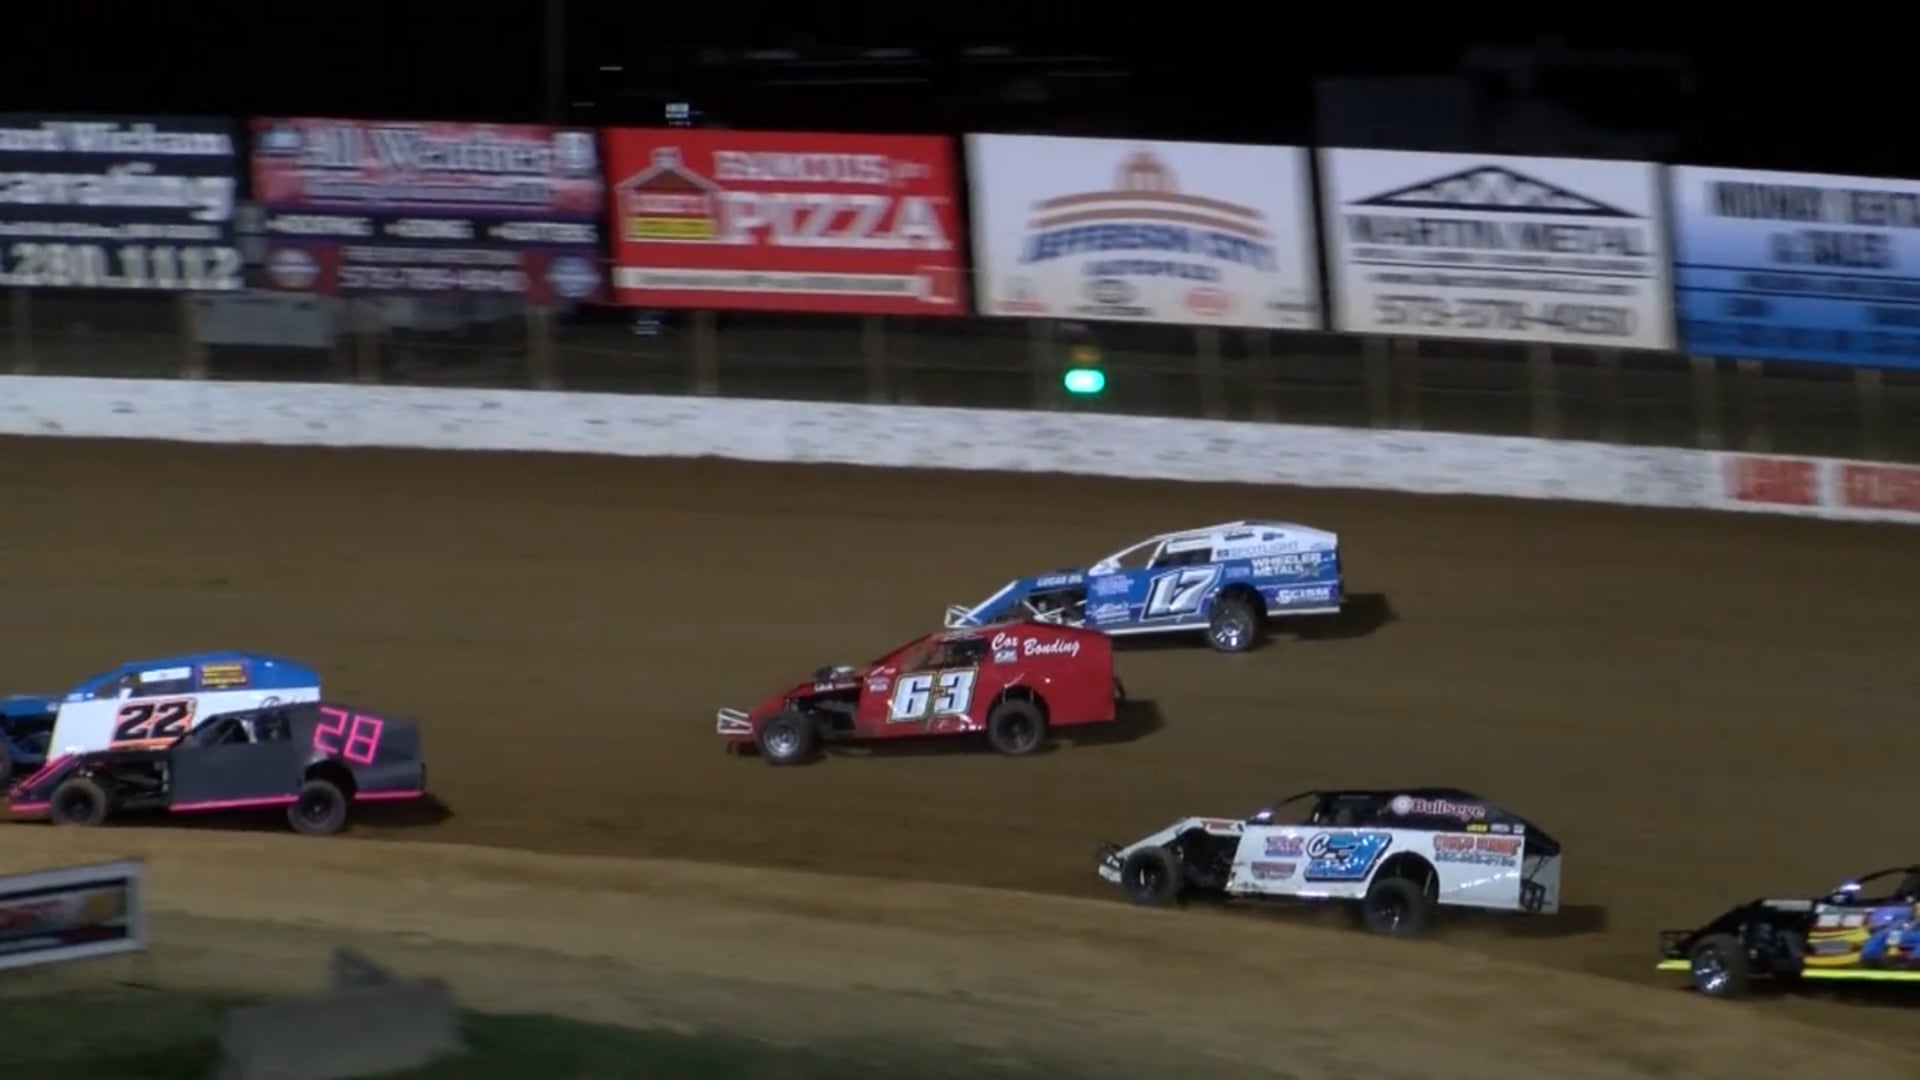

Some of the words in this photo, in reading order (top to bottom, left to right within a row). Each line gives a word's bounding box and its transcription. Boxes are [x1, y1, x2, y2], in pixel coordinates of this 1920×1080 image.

[713, 151, 887, 184] FAMOUS
[720, 191, 952, 250] PIZZA
[1020, 224, 1192, 263] JEFFERSON
[1147, 568, 1221, 616] 17
[1023, 637, 1080, 657] Bonding
[888, 667, 978, 722] 63
[112, 699, 192, 742] 22
[313, 706, 384, 764] 28
[1412, 798, 1486, 820] Bullseye
